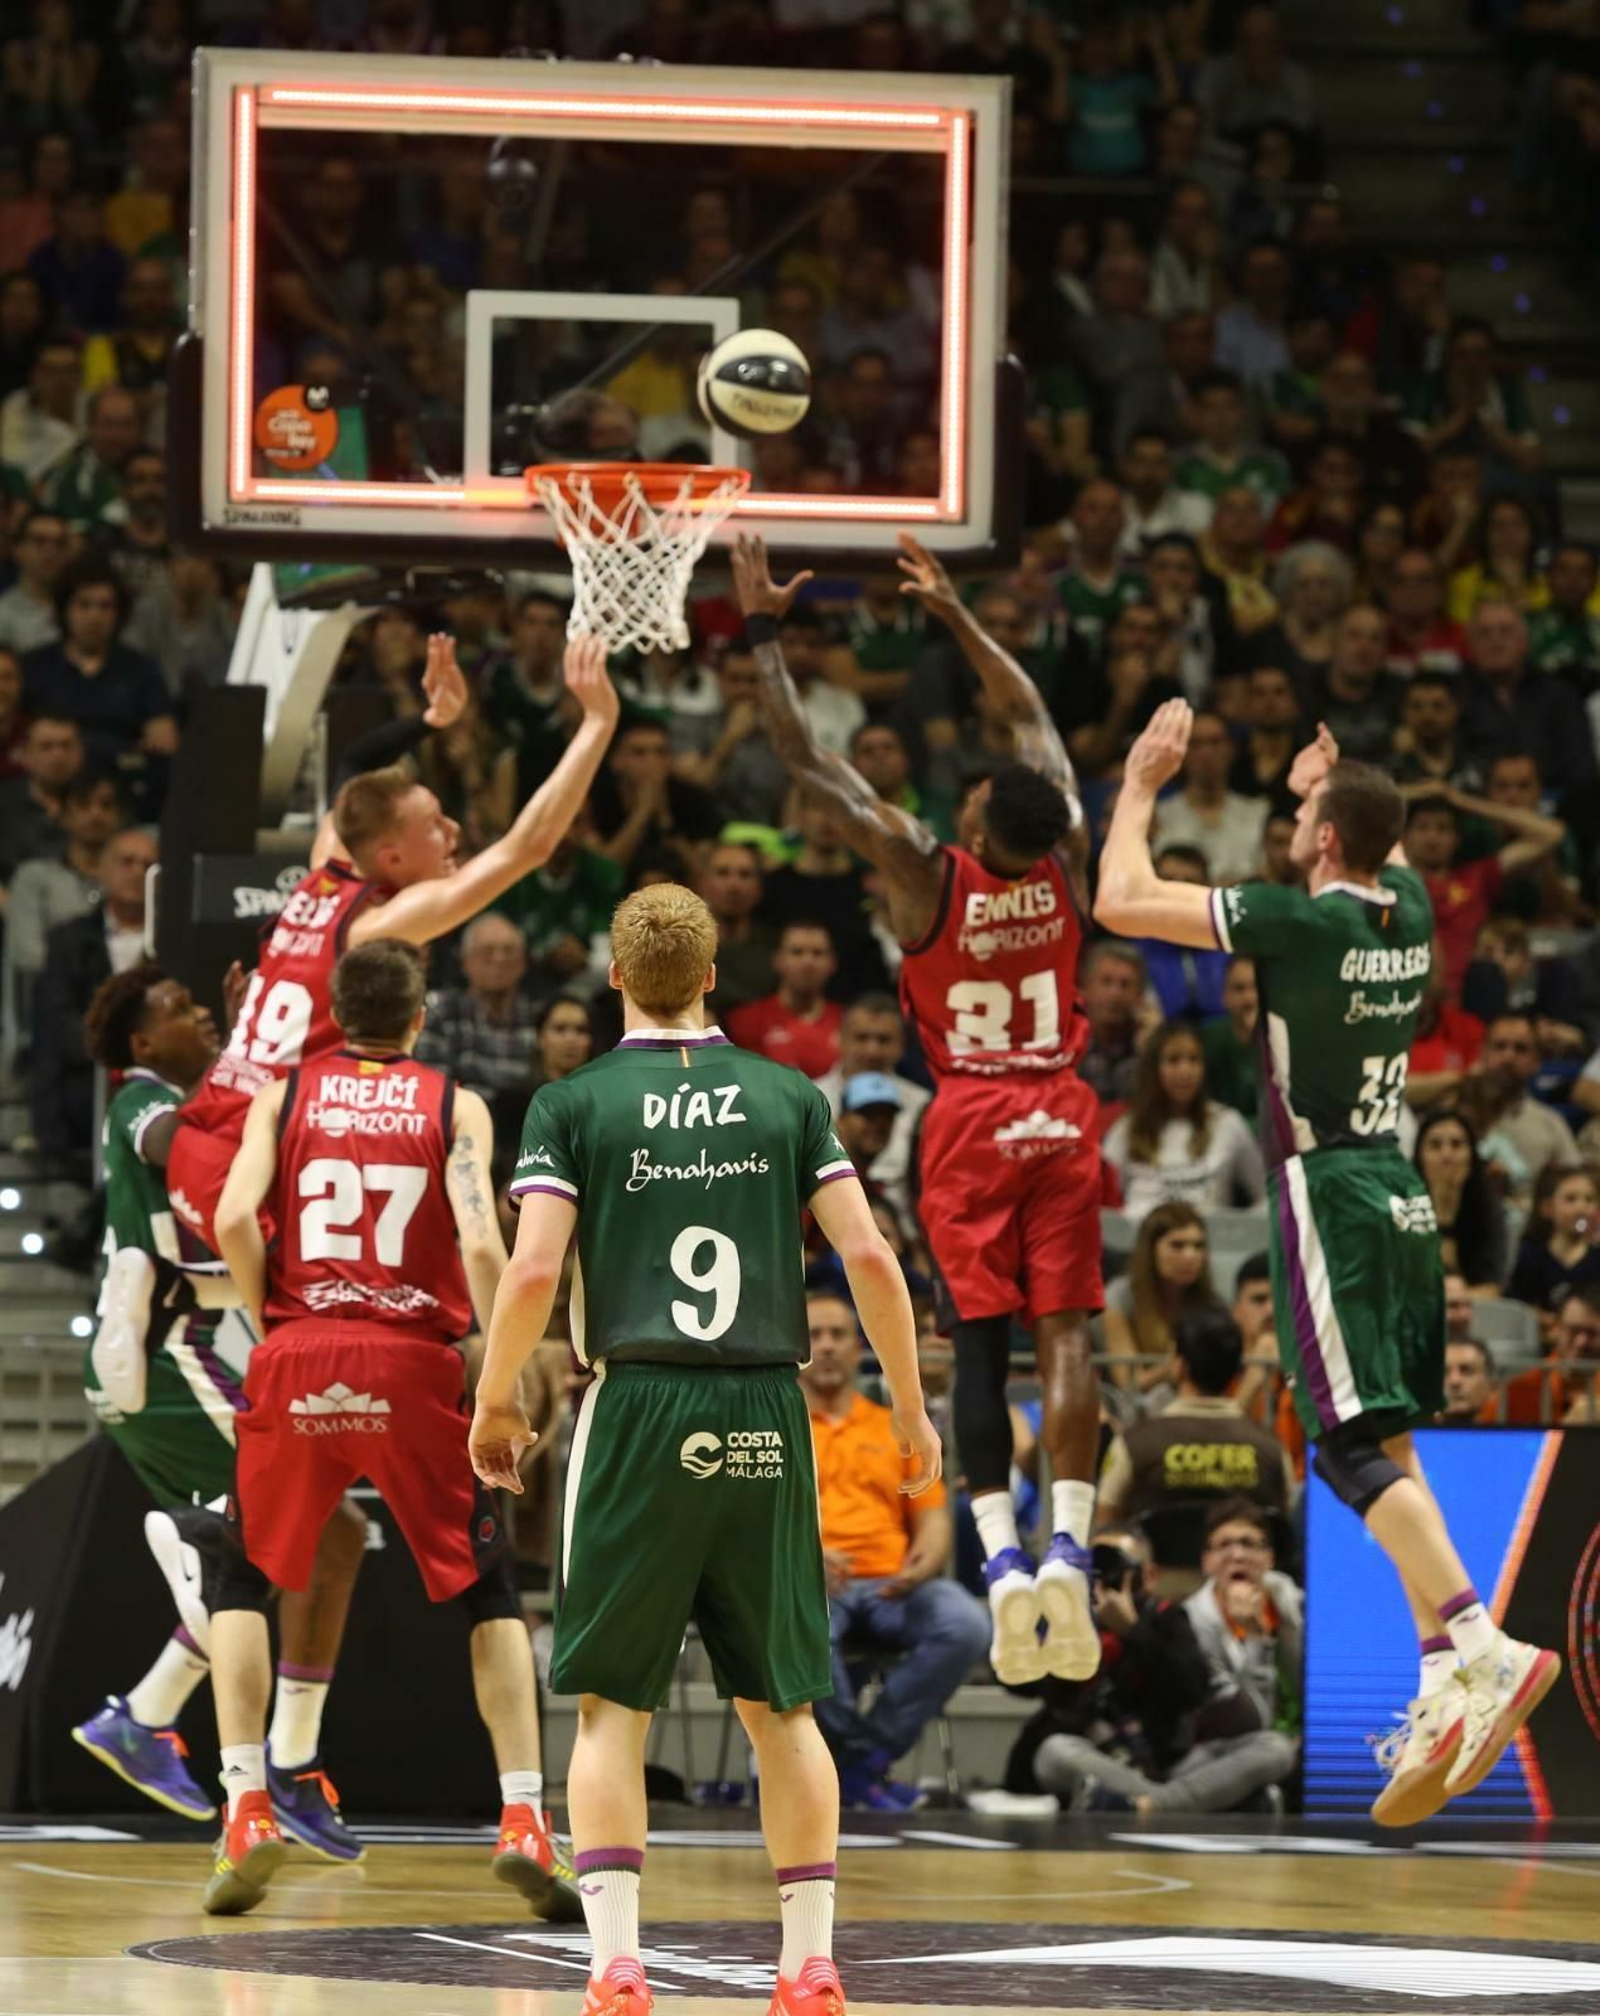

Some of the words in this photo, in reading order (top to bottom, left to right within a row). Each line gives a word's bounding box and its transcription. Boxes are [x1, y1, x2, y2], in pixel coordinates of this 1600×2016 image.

[966, 881, 1056, 927] ENNIS
[222, 972, 314, 1066] 19
[946, 969, 1060, 1056] 31
[643, 1082, 747, 1129] DÍAZ
[1350, 1051, 1409, 1136] 32
[298, 1158, 429, 1267] 27
[670, 1225, 741, 1341] 9
[292, 1416, 388, 1436] SOMMOS
[727, 1431, 784, 1448] COSTA
[725, 1463, 783, 1479] MÁLAGA
[726, 1450, 754, 1463] DEL
[756, 1449, 784, 1463] SOL
[1164, 1443, 1257, 1471] COFER
